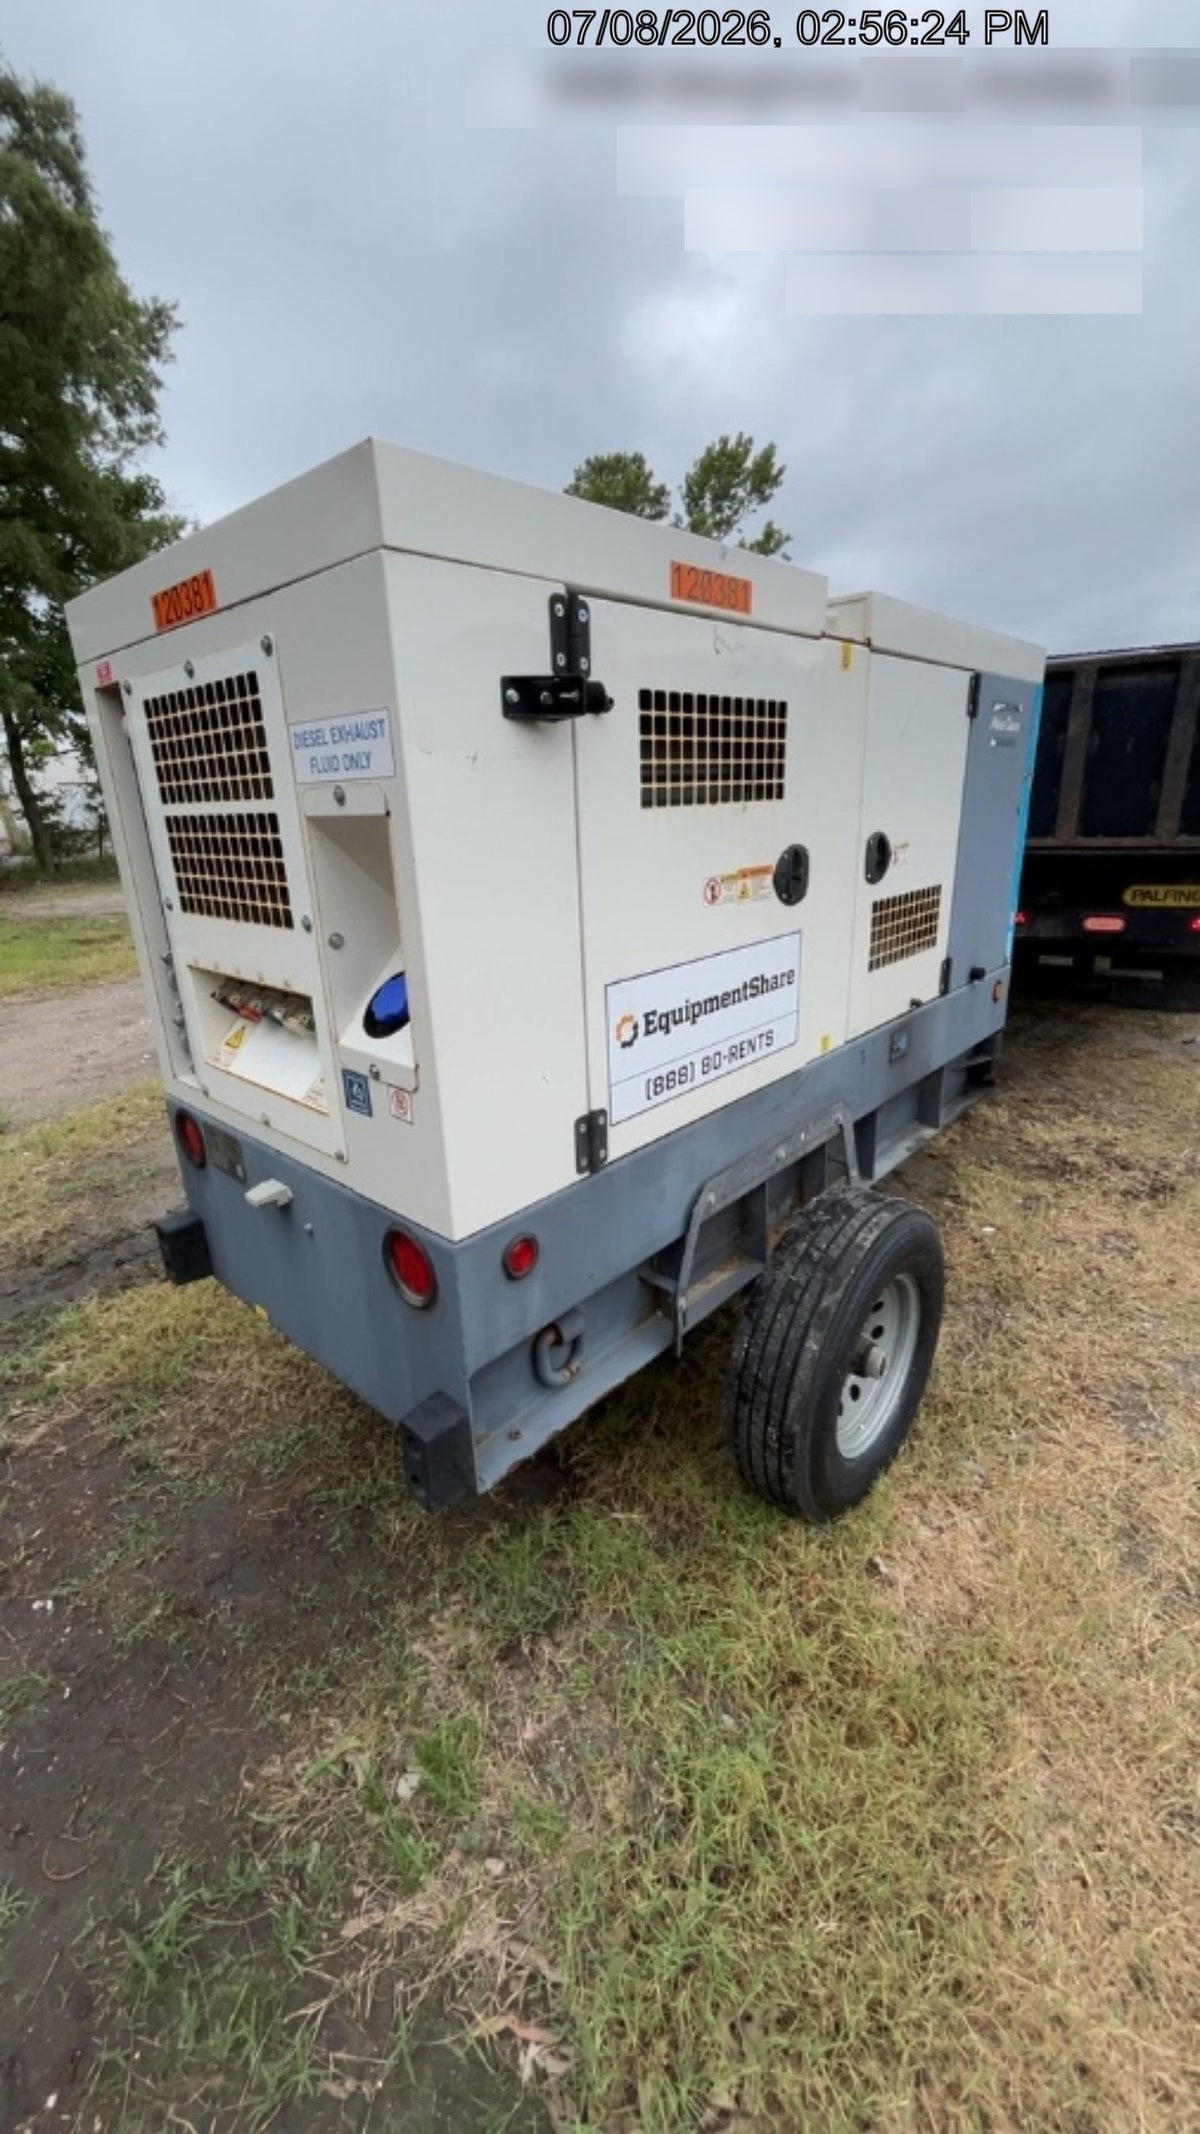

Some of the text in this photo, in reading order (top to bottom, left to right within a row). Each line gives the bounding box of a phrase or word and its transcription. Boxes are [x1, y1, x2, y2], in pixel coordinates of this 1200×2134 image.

[152, 568, 214, 629] 120381
[672, 562, 749, 613] 120381
[293, 718, 385, 750] DIESEL EXHAUST
[310, 751, 372, 774] FLUID ONLY
[642, 968, 796, 1037] EquipmentShare
[644, 1029, 774, 1101] (888) 80-RENTS
